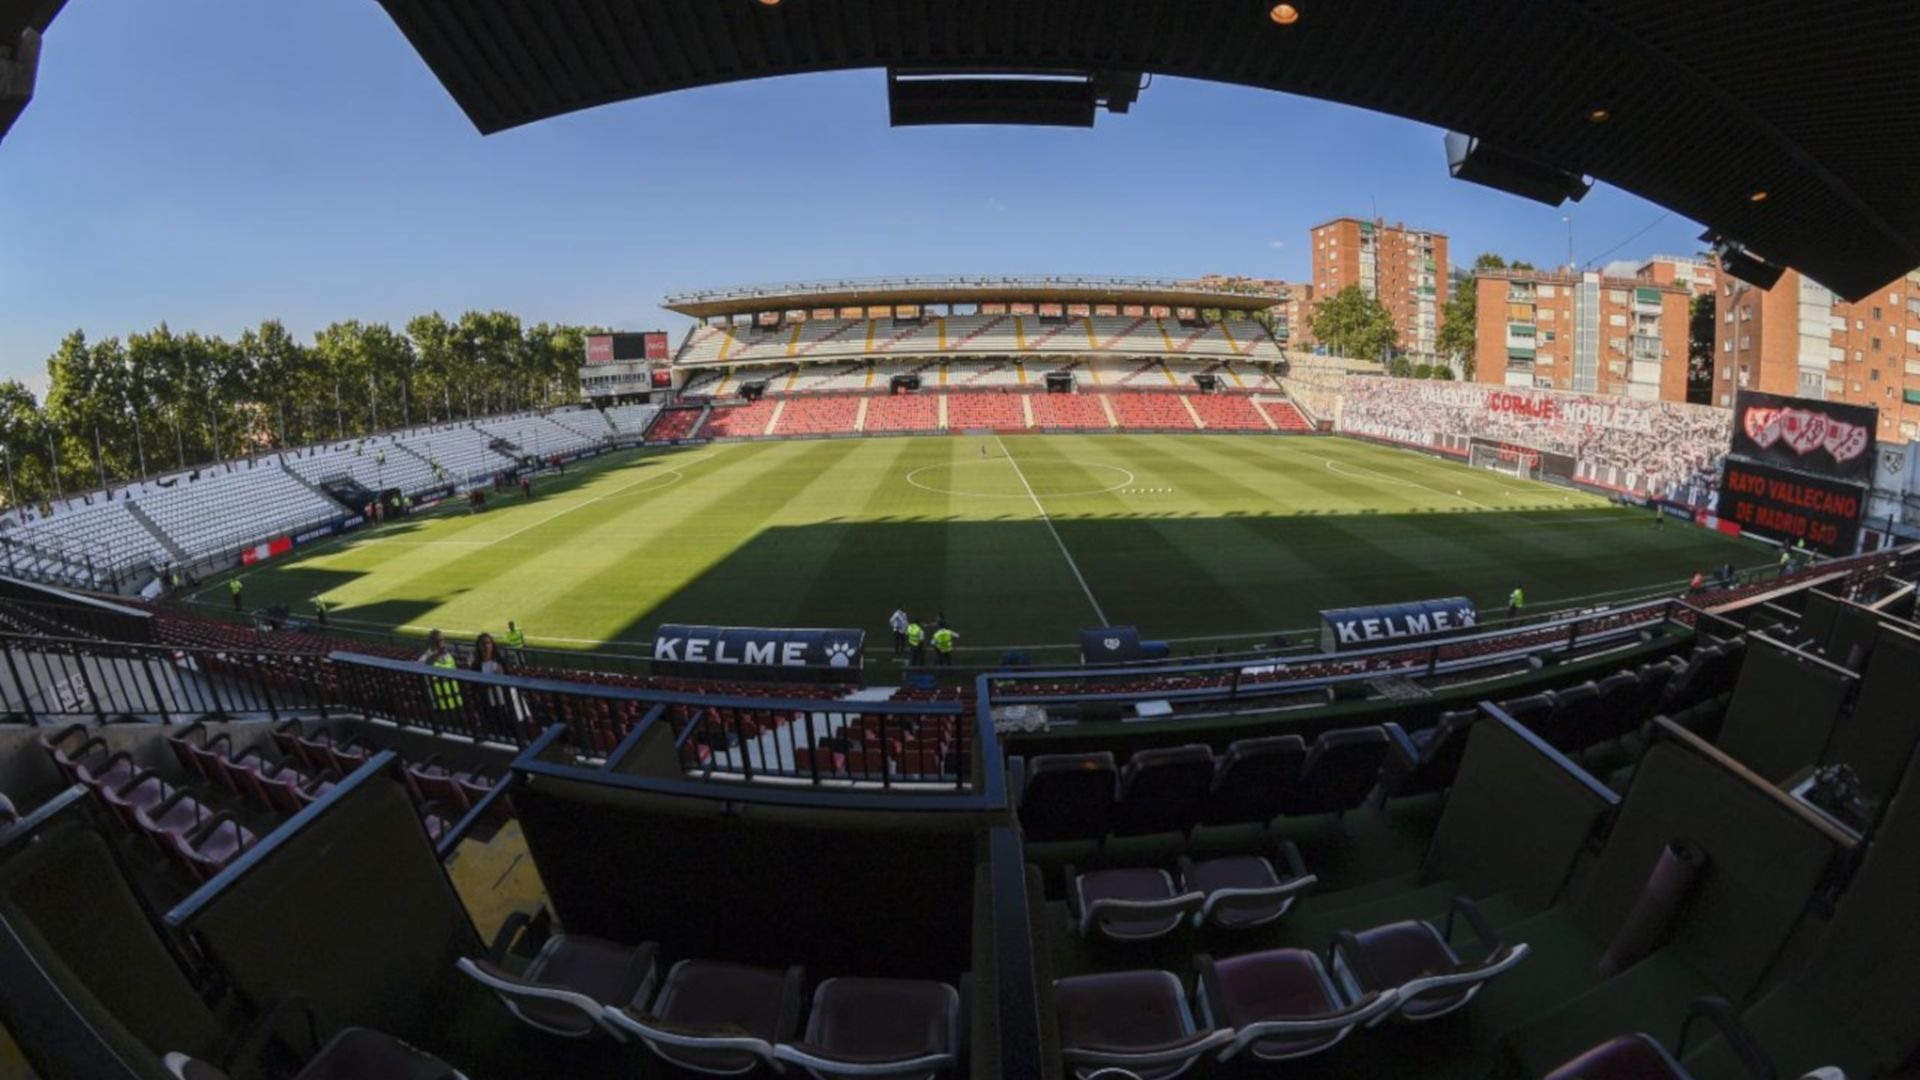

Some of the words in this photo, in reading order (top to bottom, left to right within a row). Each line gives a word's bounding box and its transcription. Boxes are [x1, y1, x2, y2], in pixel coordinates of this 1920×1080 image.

[1490, 393, 1552, 419] CORAJE
[1563, 402, 1651, 432] NOBLEZA
[1730, 473, 1765, 496] RAYO
[1769, 480, 1856, 517] VALLECANO
[1736, 501, 1752, 521] DE
[1757, 507, 1806, 537] MADRID
[1336, 611, 1451, 643] KELME
[654, 636, 809, 666] KELME
